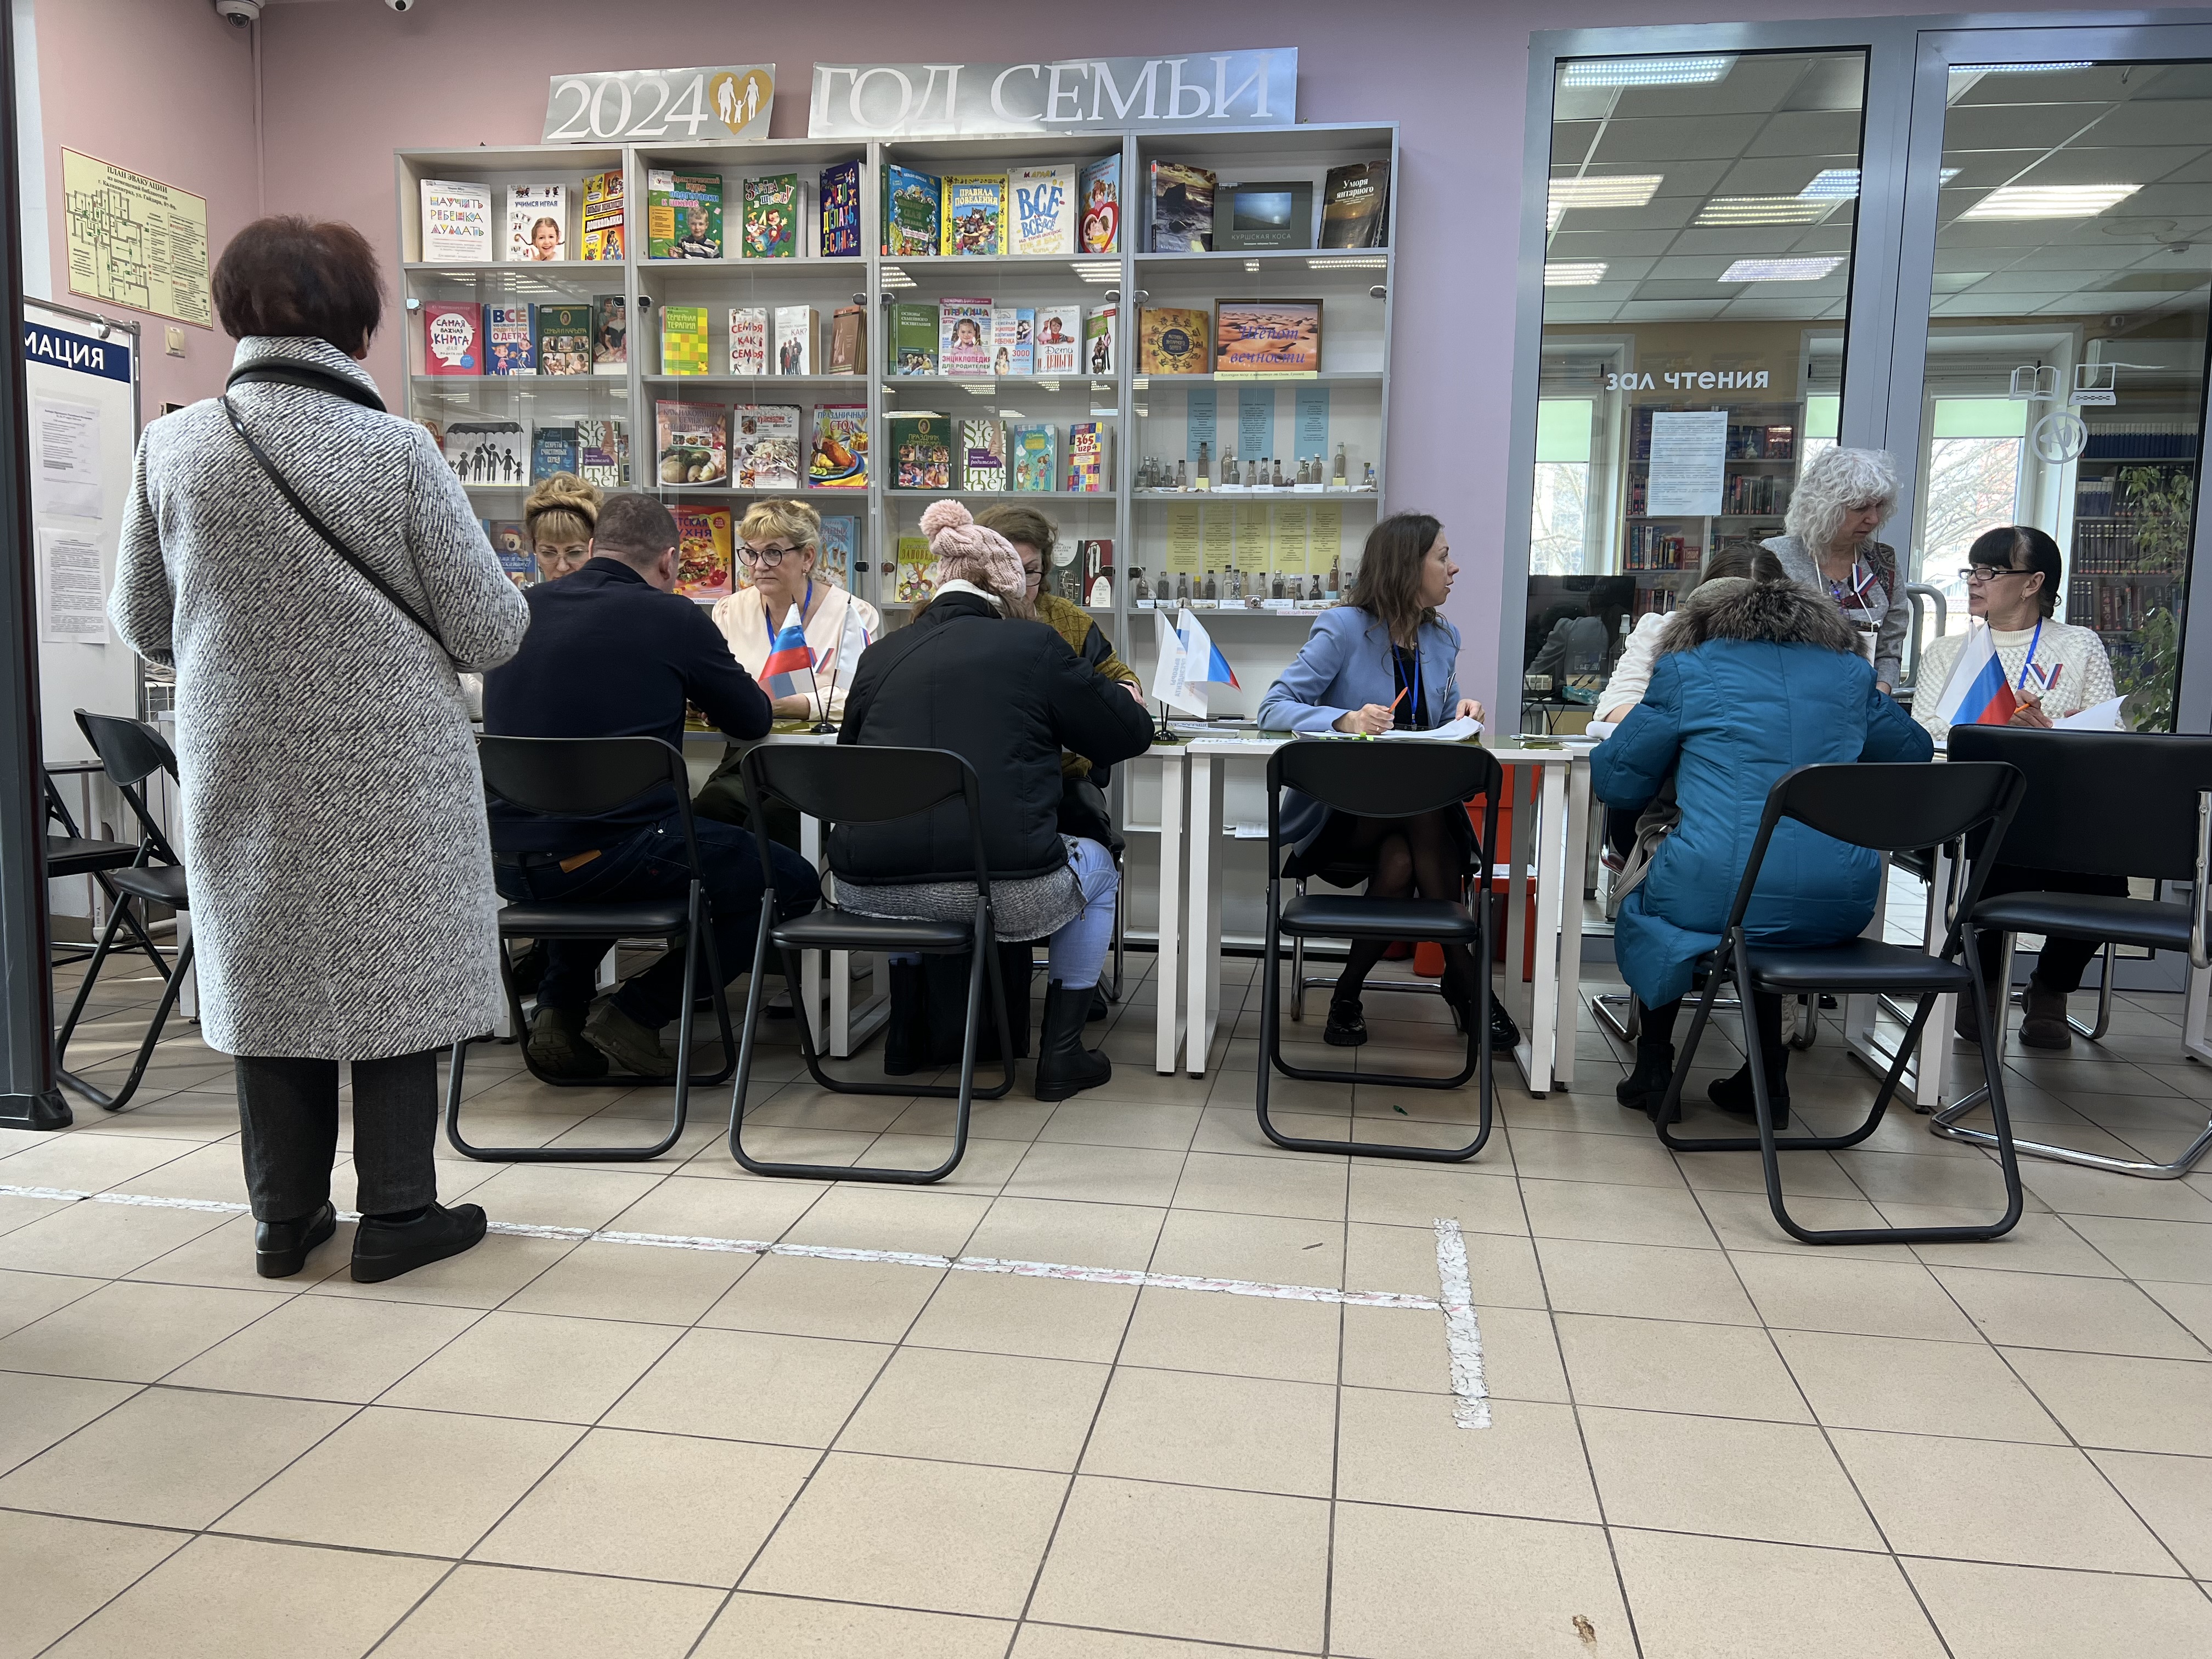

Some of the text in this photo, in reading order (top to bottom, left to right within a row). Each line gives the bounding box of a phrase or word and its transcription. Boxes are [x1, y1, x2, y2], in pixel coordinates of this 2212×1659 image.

[815, 53, 1276, 127] ГОД СЕМЬИ
[547, 78, 708, 139] 2024
[107, 166, 167, 193] ПЛАН ЭВАКУАЦИИ
[671, 175, 720, 184] Практический
[1343, 178, 1368, 189] У моря
[669, 191, 719, 202] подготовки
[960, 189, 993, 197] ПРАВИЛА
[1336, 187, 1374, 198] янтарного
[430, 196, 483, 209] НАУЧИТЬ
[669, 199, 699, 207] школе
[955, 196, 998, 206] ПОВЕДЕНИЯ
[431, 210, 483, 223] РЕБЕНКА
[586, 214, 623, 233] ДОШКОЛЬНИКА
[431, 224, 484, 236] ДУМАТЬ
[1042, 229, 1062, 238] вопрос
[436, 319, 465, 328] САМАЯ
[731, 320, 763, 334] СЕМЬЯ
[501, 332, 527, 341] ДЕТЯХ
[1239, 325, 1299, 340] Шёпот
[434, 334, 469, 346] КНИГА
[737, 336, 757, 346] КАК
[732, 349, 763, 359] СЕМЬЯ
[1045, 346, 1073, 354] Дети
[1230, 352, 1305, 364] вечности
[1605, 370, 1769, 391] зал чтения
[830, 420, 854, 431] СТОЛ
[1076, 435, 1093, 446] 365
